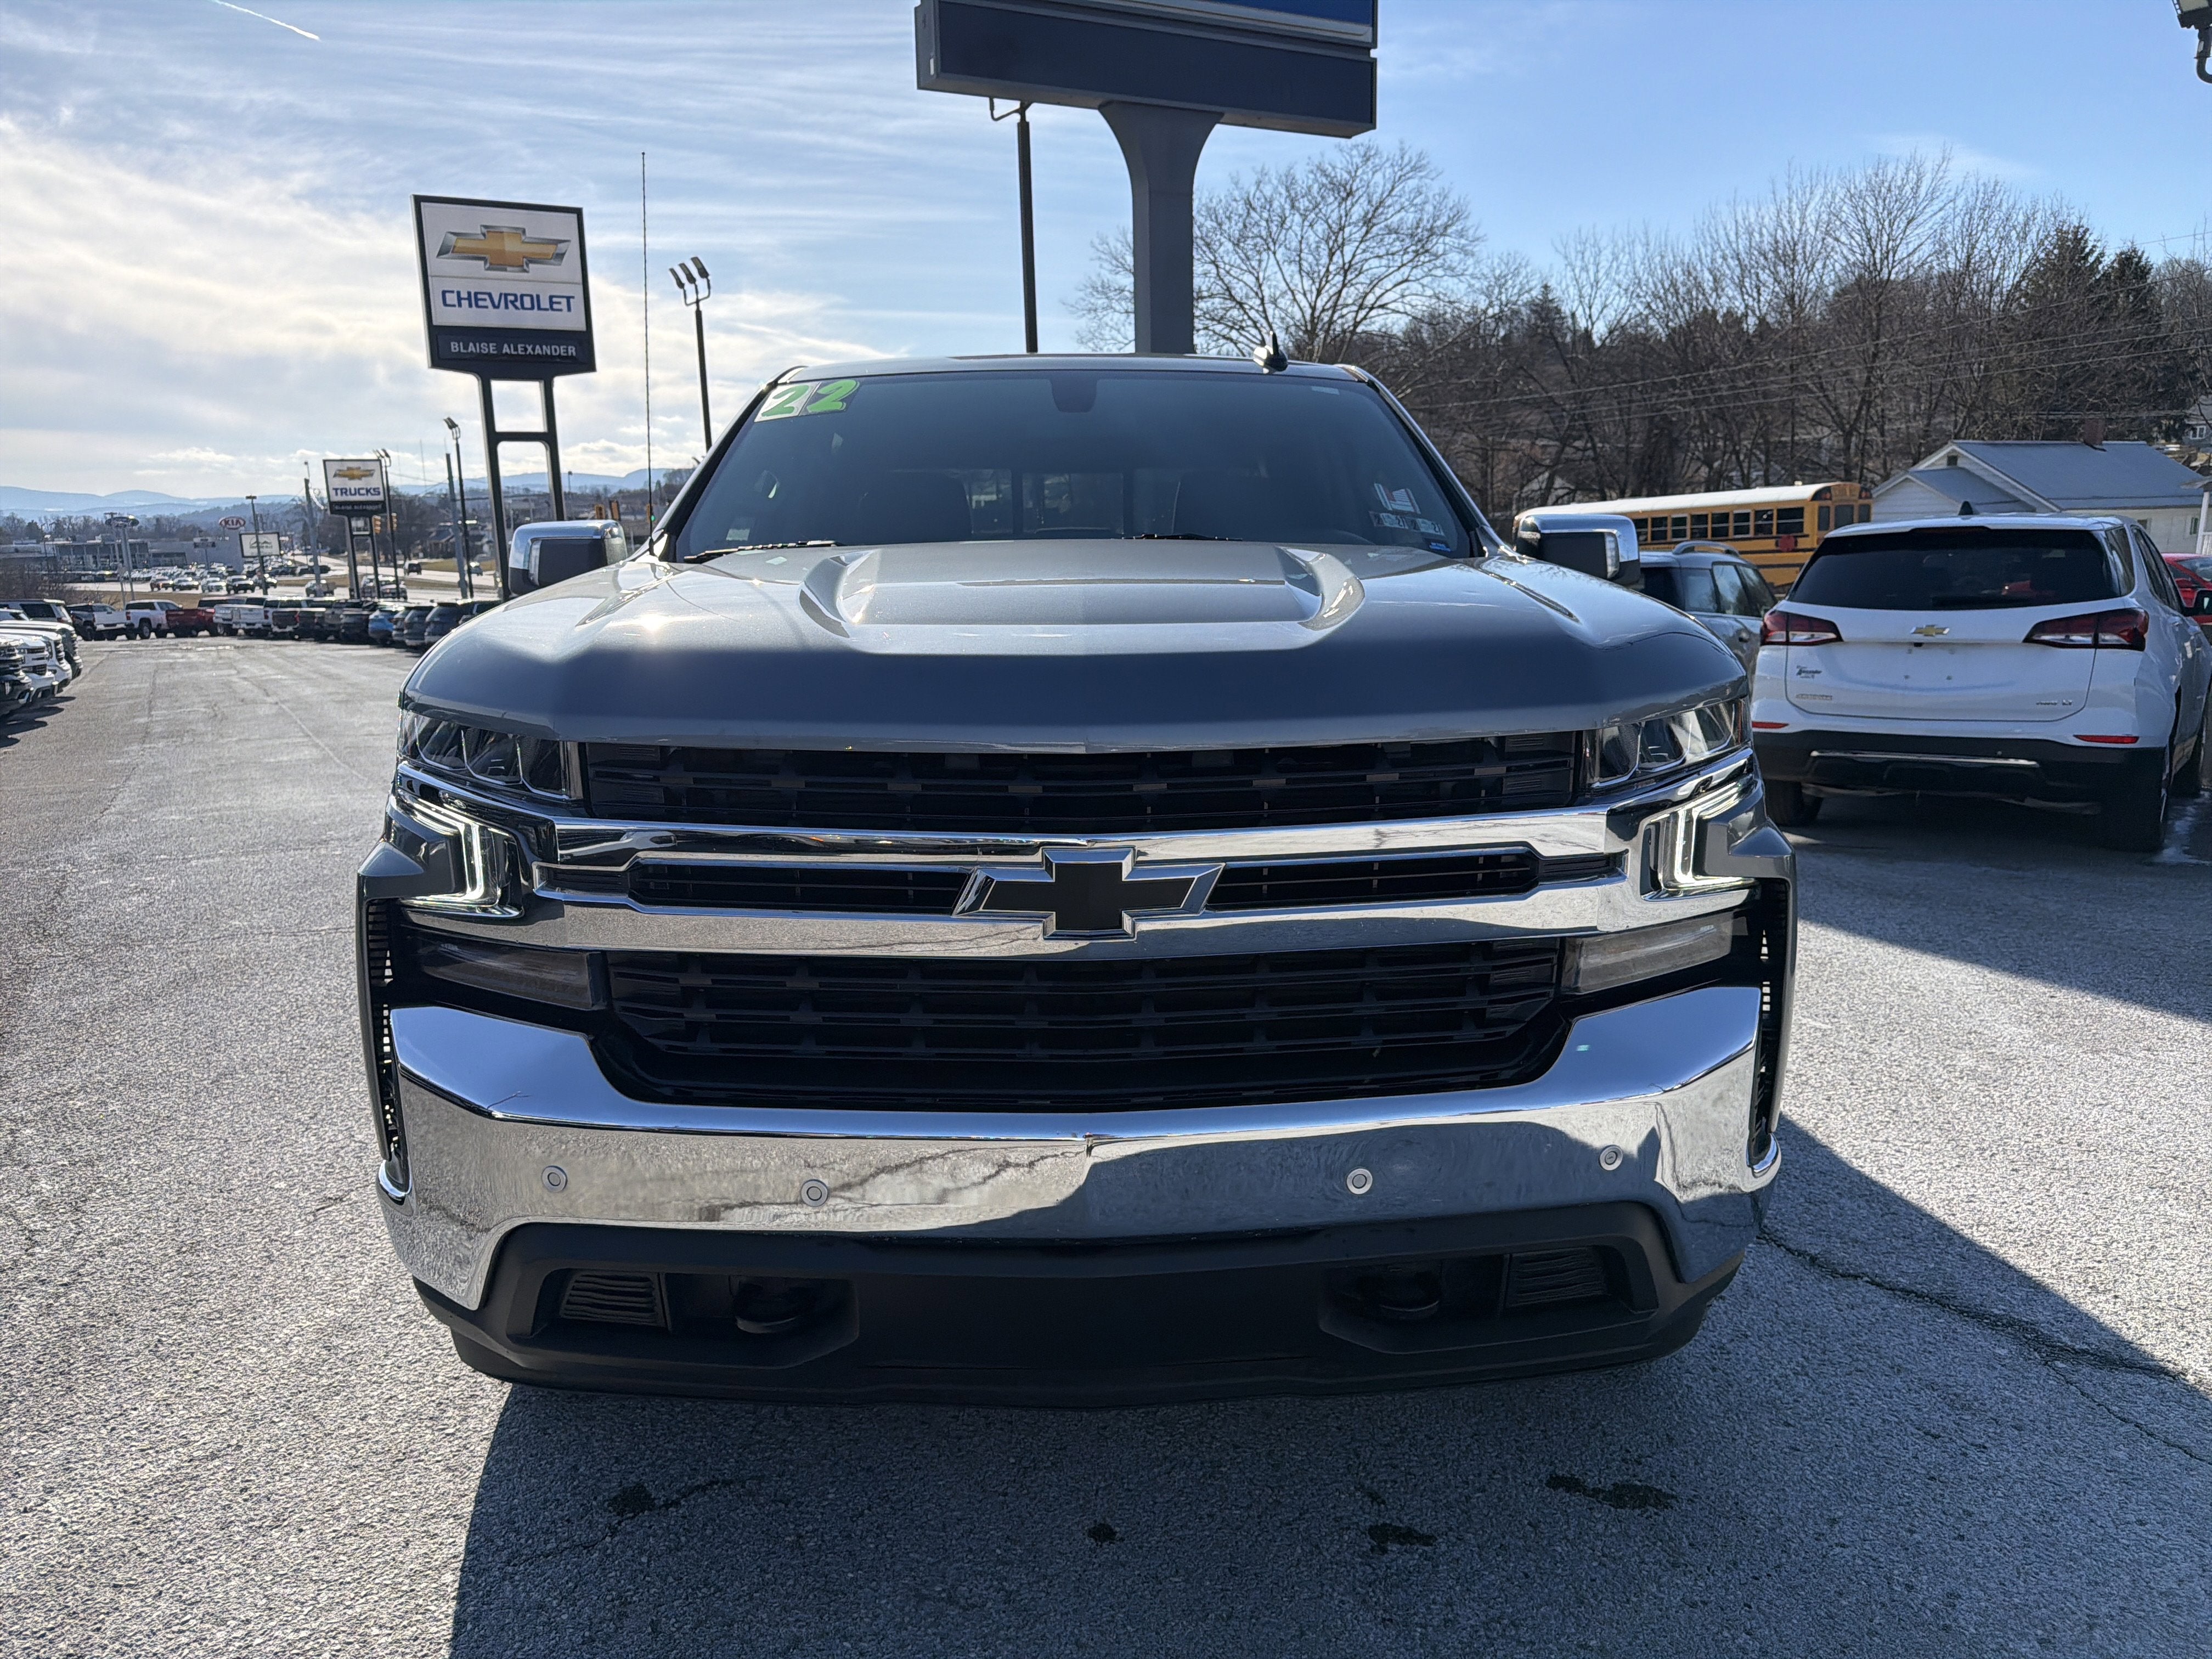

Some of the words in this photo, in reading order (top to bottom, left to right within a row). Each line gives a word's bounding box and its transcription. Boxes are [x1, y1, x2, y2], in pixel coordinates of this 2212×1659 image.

[441, 289, 575, 313] CHEVROLET
[450, 341, 498, 354] BLAISE
[502, 342, 577, 357] ALEXANDER
[332, 487, 381, 496] TRUCKS
